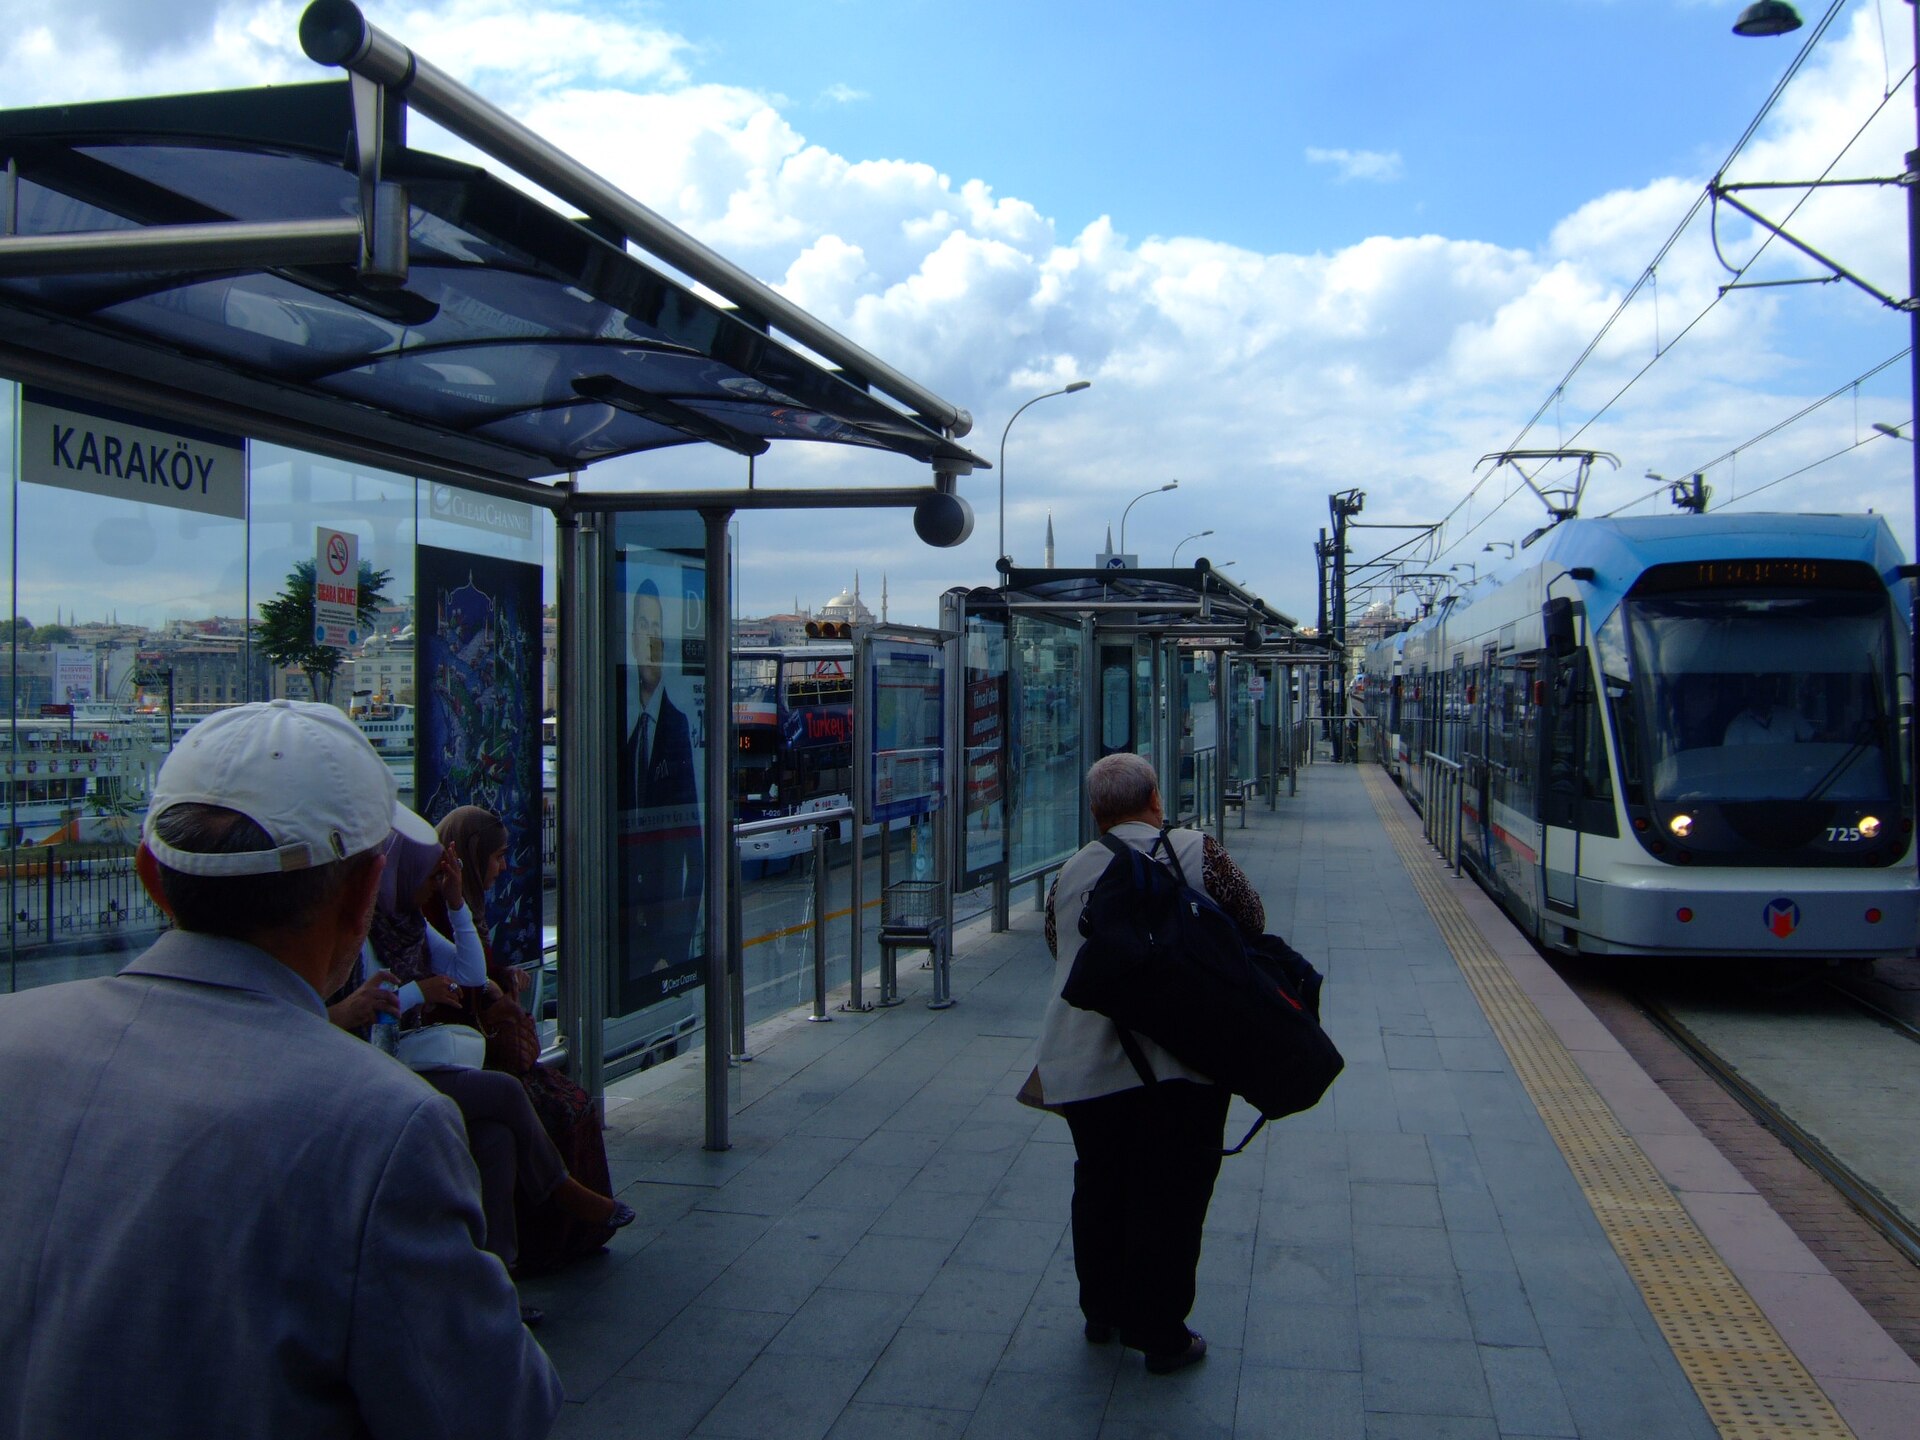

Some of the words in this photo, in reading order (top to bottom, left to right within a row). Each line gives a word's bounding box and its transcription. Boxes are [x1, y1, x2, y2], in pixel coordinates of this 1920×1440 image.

[53, 423, 214, 494] KARAKÖY
[805, 708, 845, 742] Turkey
[1826, 827, 1861, 842] 725
